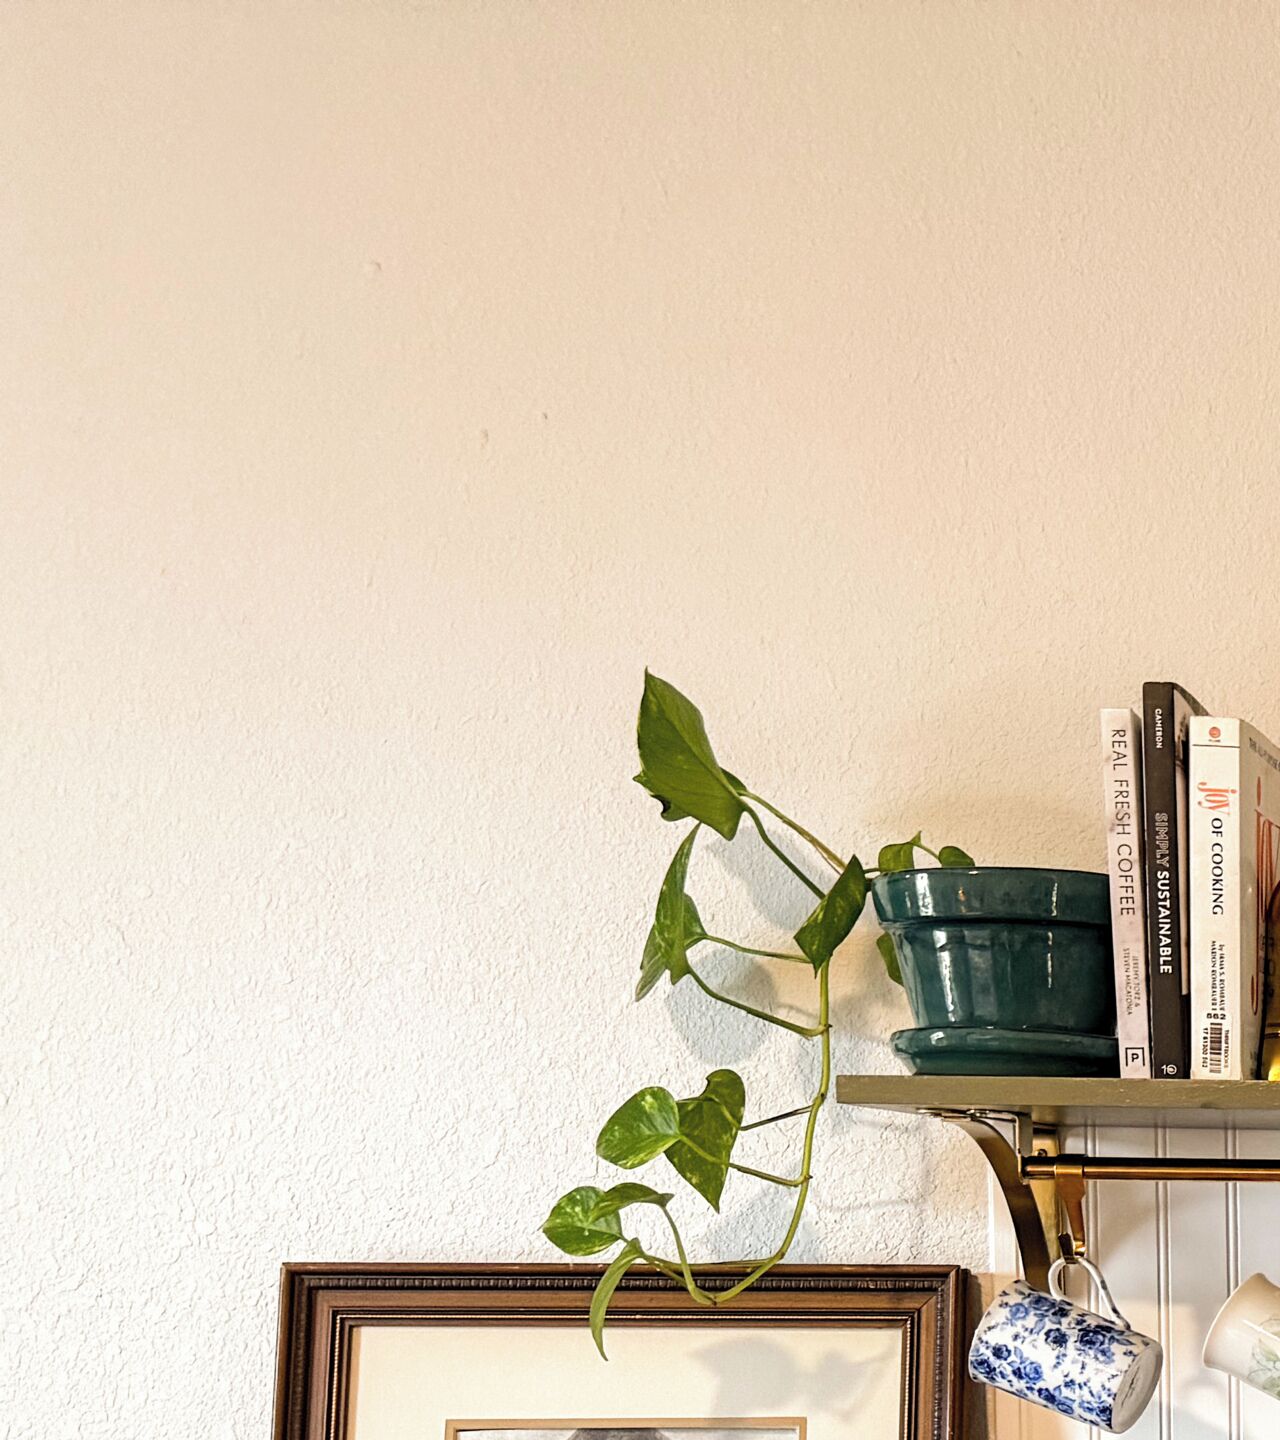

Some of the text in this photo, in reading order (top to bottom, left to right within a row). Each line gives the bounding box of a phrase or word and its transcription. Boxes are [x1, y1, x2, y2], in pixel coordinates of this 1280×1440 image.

[1155, 708, 1163, 749] CAMERON
[1111, 729, 1136, 916] REAL FRESH COFFEE
[1211, 818, 1223, 838] OF
[1155, 812, 1172, 974] SIMPLY SUSTAINABLE
[1211, 842, 1224, 915] COOKING
[1123, 948, 1131, 973] STEVEN
